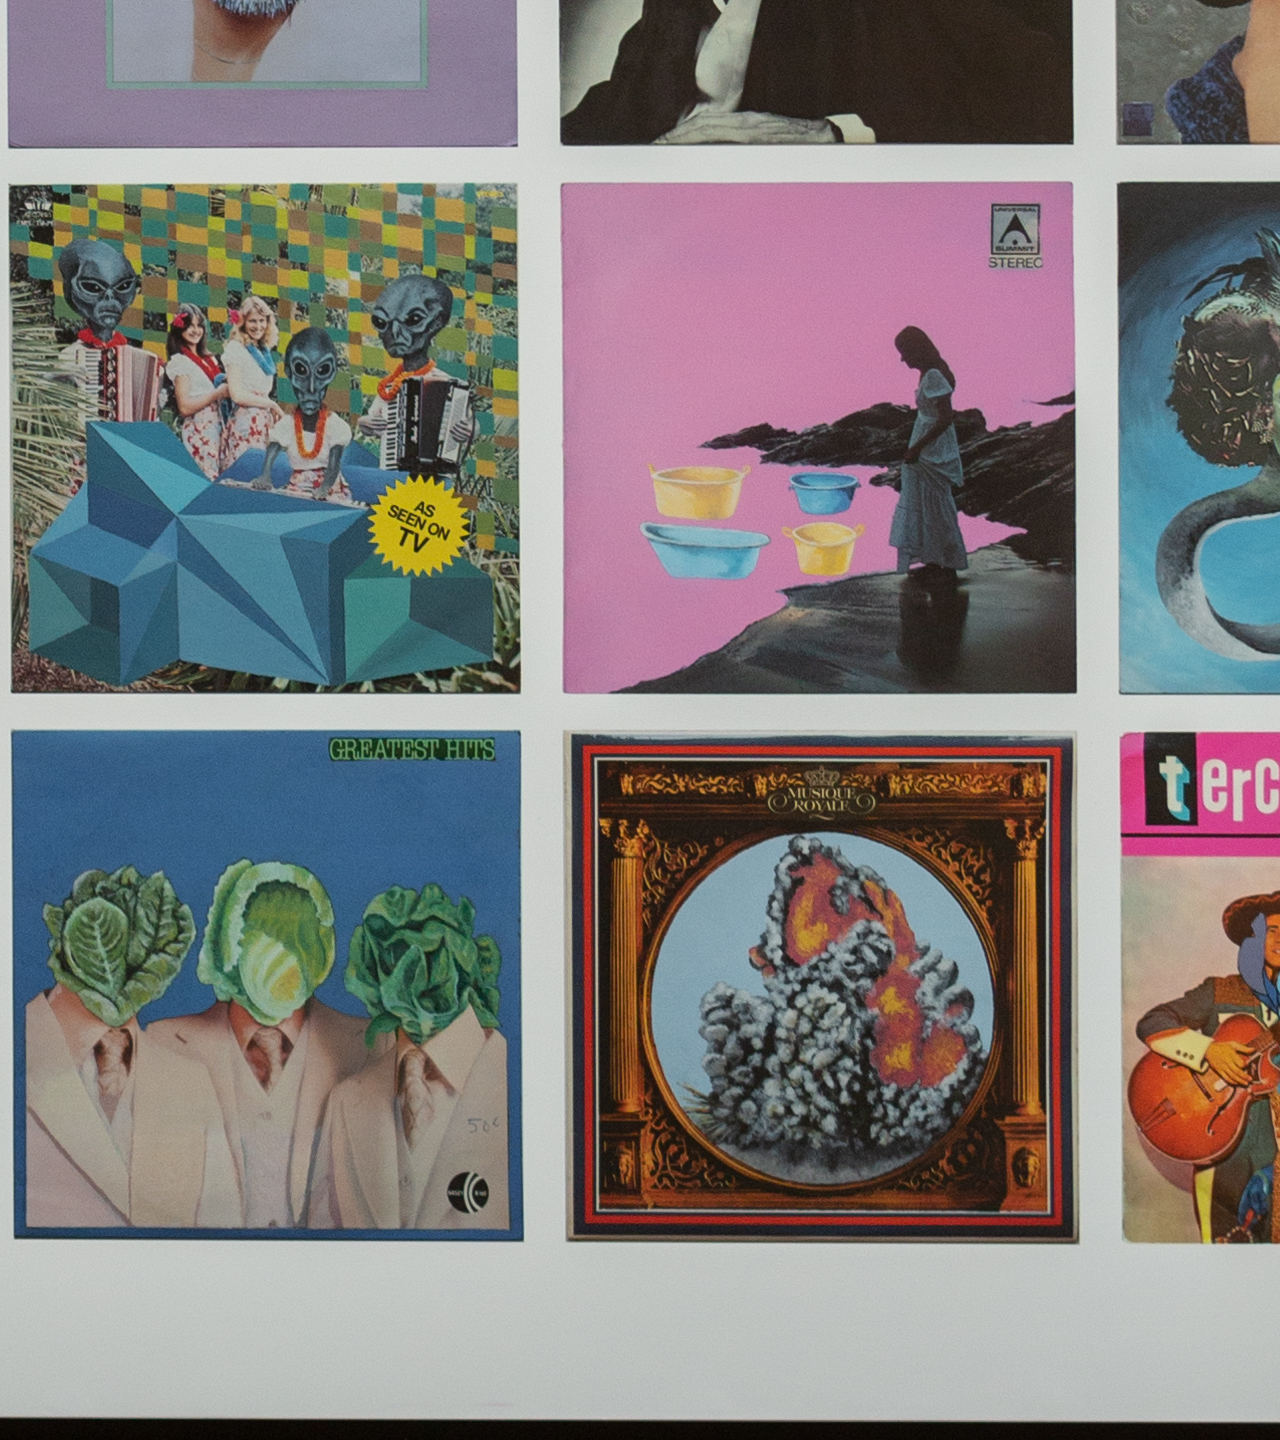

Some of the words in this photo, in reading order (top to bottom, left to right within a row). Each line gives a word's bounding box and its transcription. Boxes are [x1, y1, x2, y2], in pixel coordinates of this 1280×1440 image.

[413, 501, 436, 518] AS
[388, 504, 427, 531] SEEN
[428, 522, 450, 541] ON
[399, 526, 430, 553] TV
[329, 738, 440, 761] GREATEST
[444, 738, 496, 761] HITS
[788, 787, 856, 800] MUSIQUE
[792, 800, 850, 813] ROYALE
